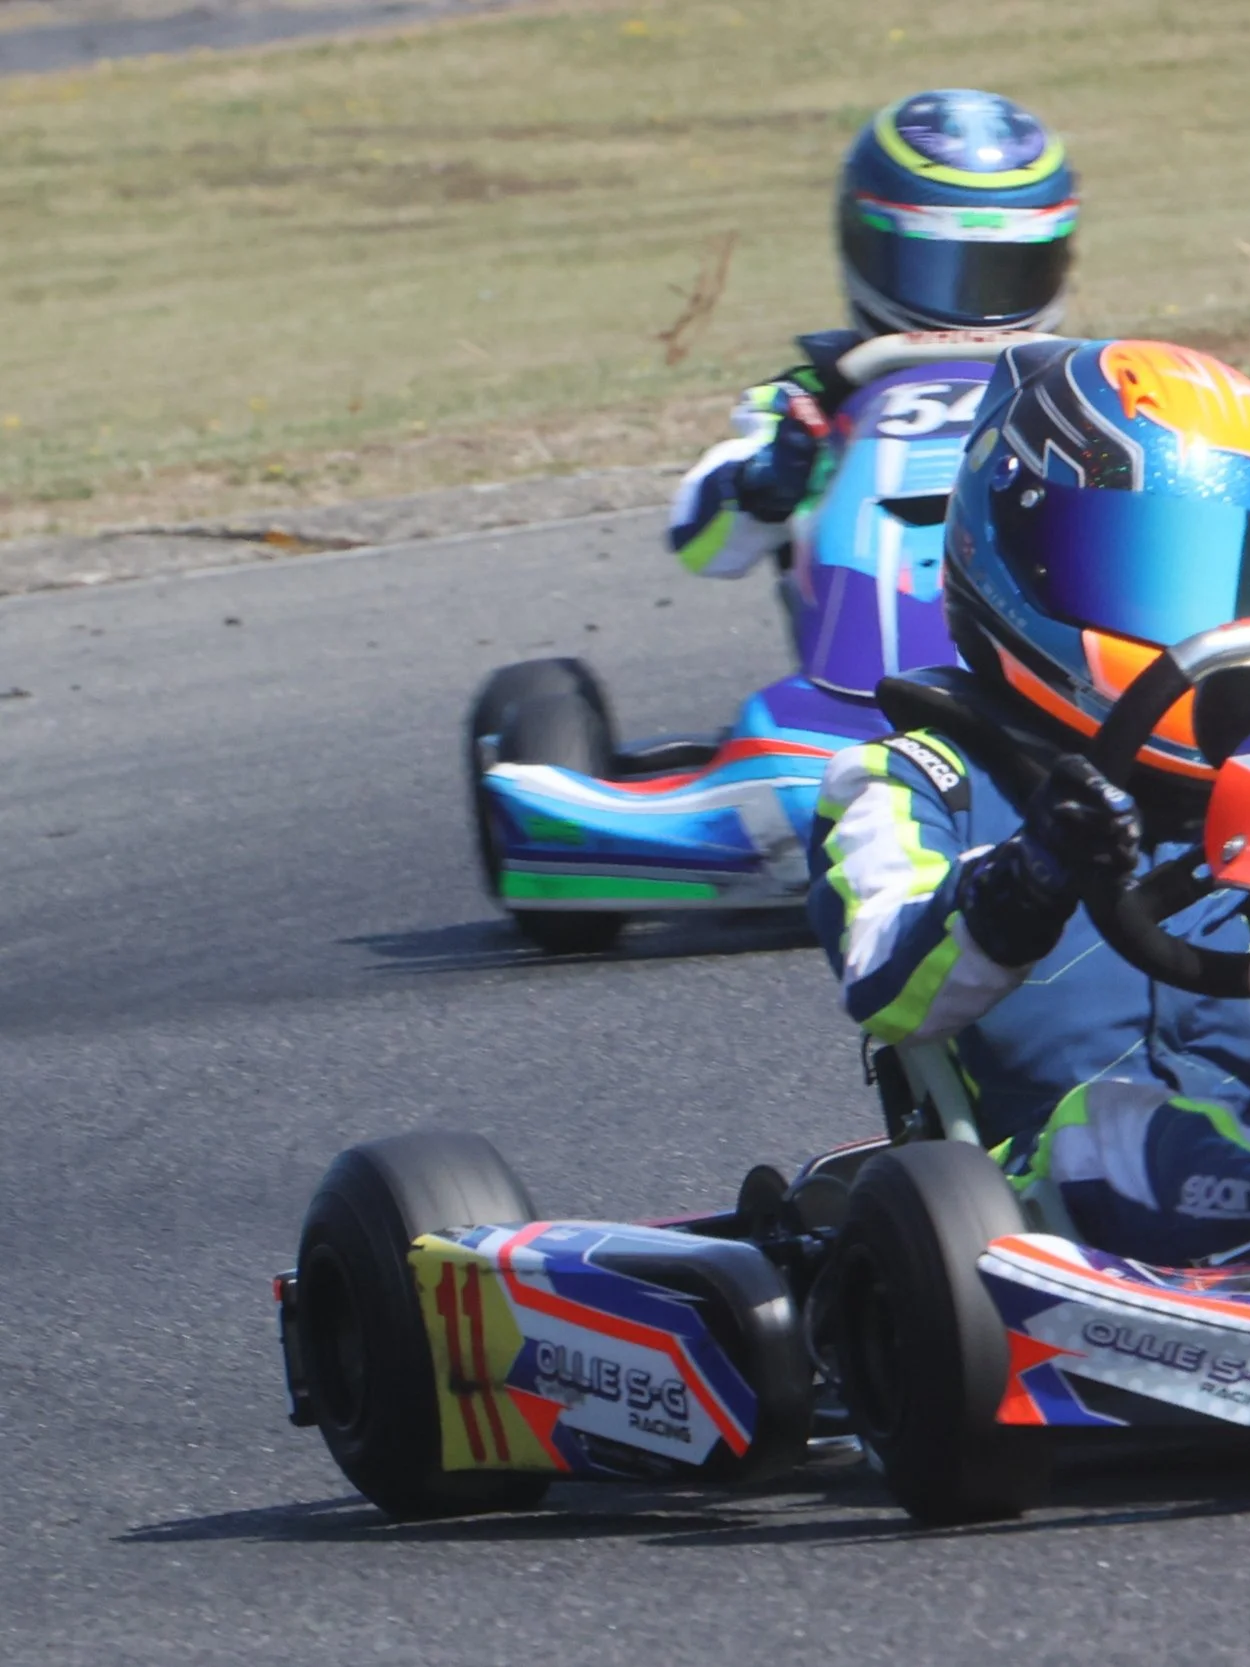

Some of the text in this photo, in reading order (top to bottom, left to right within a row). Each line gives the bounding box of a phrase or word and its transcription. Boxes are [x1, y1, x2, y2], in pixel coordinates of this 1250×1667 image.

[435, 1261, 511, 1462] 11
[536, 1339, 621, 1402] OLLIE
[1083, 1319, 1205, 1372] OLLIE
